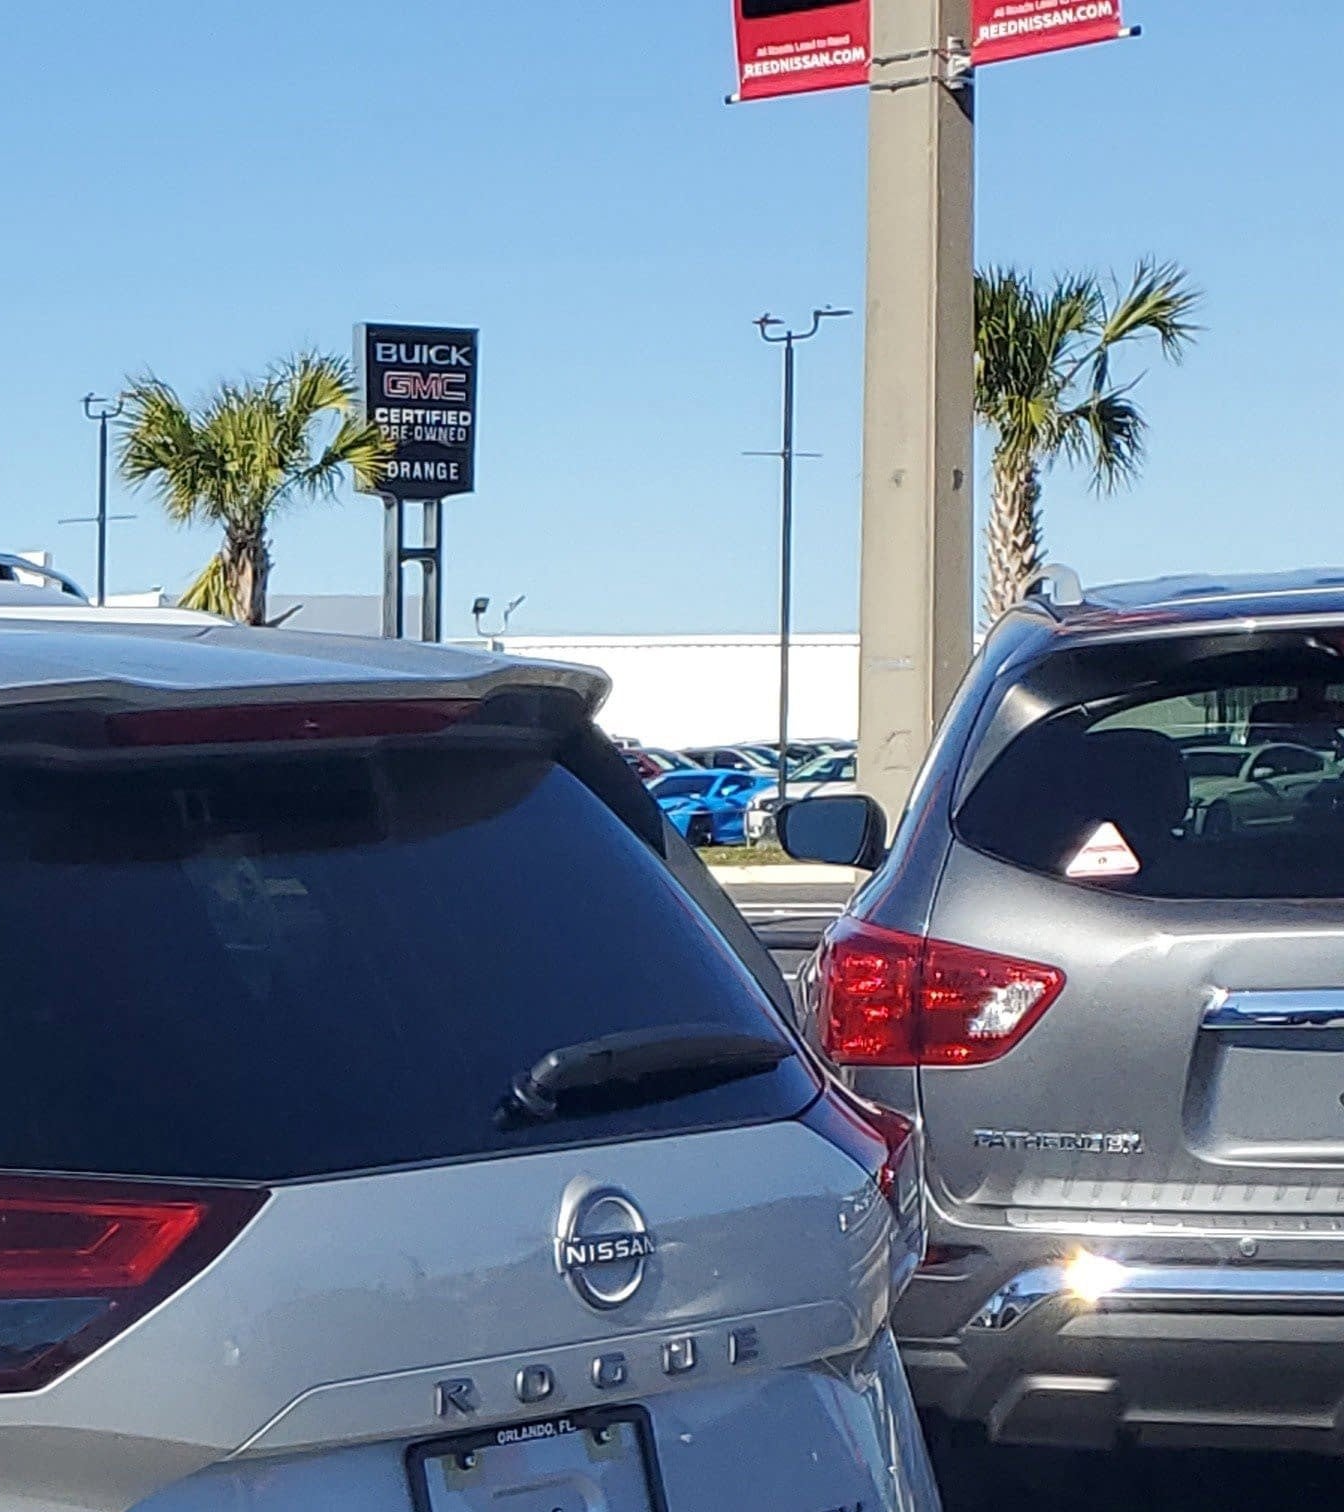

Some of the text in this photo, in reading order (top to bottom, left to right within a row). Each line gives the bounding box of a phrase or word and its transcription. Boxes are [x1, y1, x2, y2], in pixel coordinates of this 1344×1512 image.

[979, 1, 1113, 40] REEDNISSAN.COM
[743, 46, 865, 77] REEDNISSAN.COM
[375, 343, 472, 367] BUICK
[384, 371, 466, 402] GMC
[375, 407, 472, 426] CERTIFIED
[380, 424, 467, 442] PRE-OWNED
[388, 460, 460, 481] ORANGE
[566, 1235, 655, 1265] NISSAN
[434, 1326, 760, 1421] ROGUE
[496, 1422, 558, 1444] ORLANDO,
